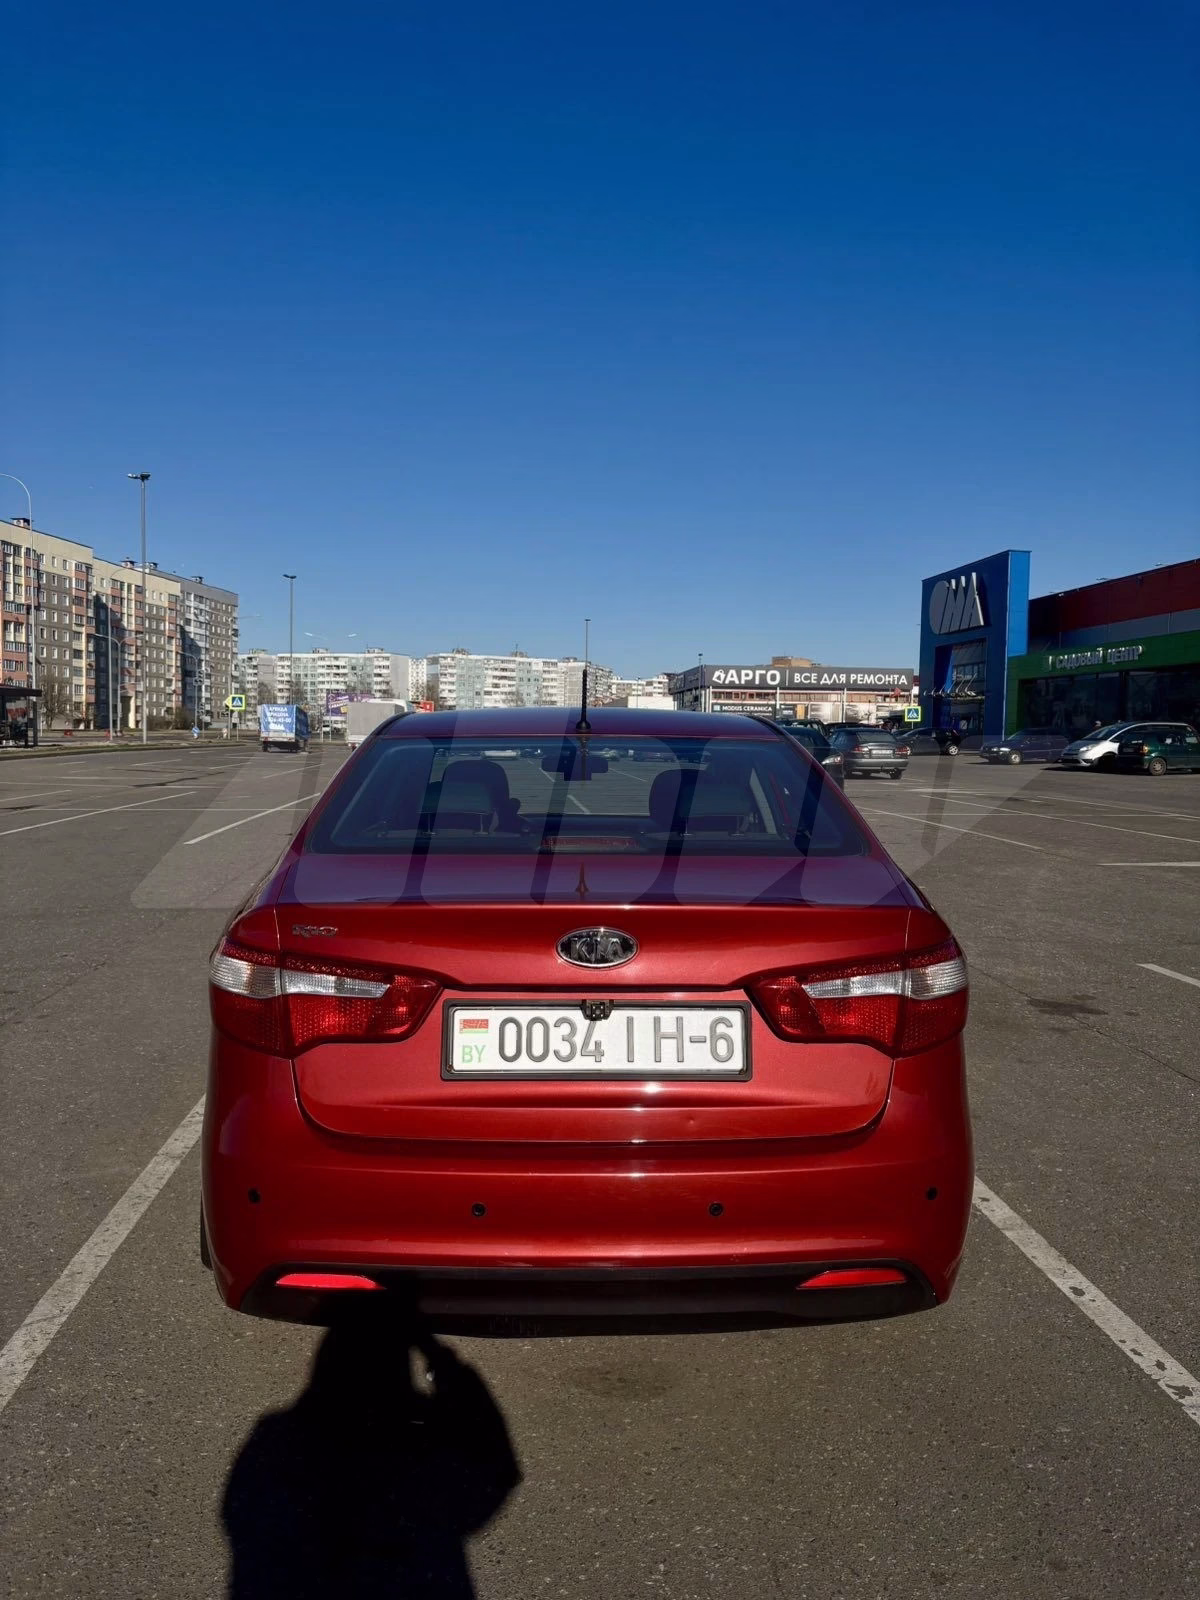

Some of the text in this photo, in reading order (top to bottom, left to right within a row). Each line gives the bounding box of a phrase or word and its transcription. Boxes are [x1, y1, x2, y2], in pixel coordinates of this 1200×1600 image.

[1056, 645, 1143, 669] САДОВЫЙ ЦЕНТР
[724, 669, 781, 686] АРГО
[793, 672, 908, 685] ВСЕ ДЛЯ РЕМОНТА
[569, 936, 624, 961] KIA
[498, 1016, 605, 1063] 0034
[461, 1044, 486, 1064] BY
